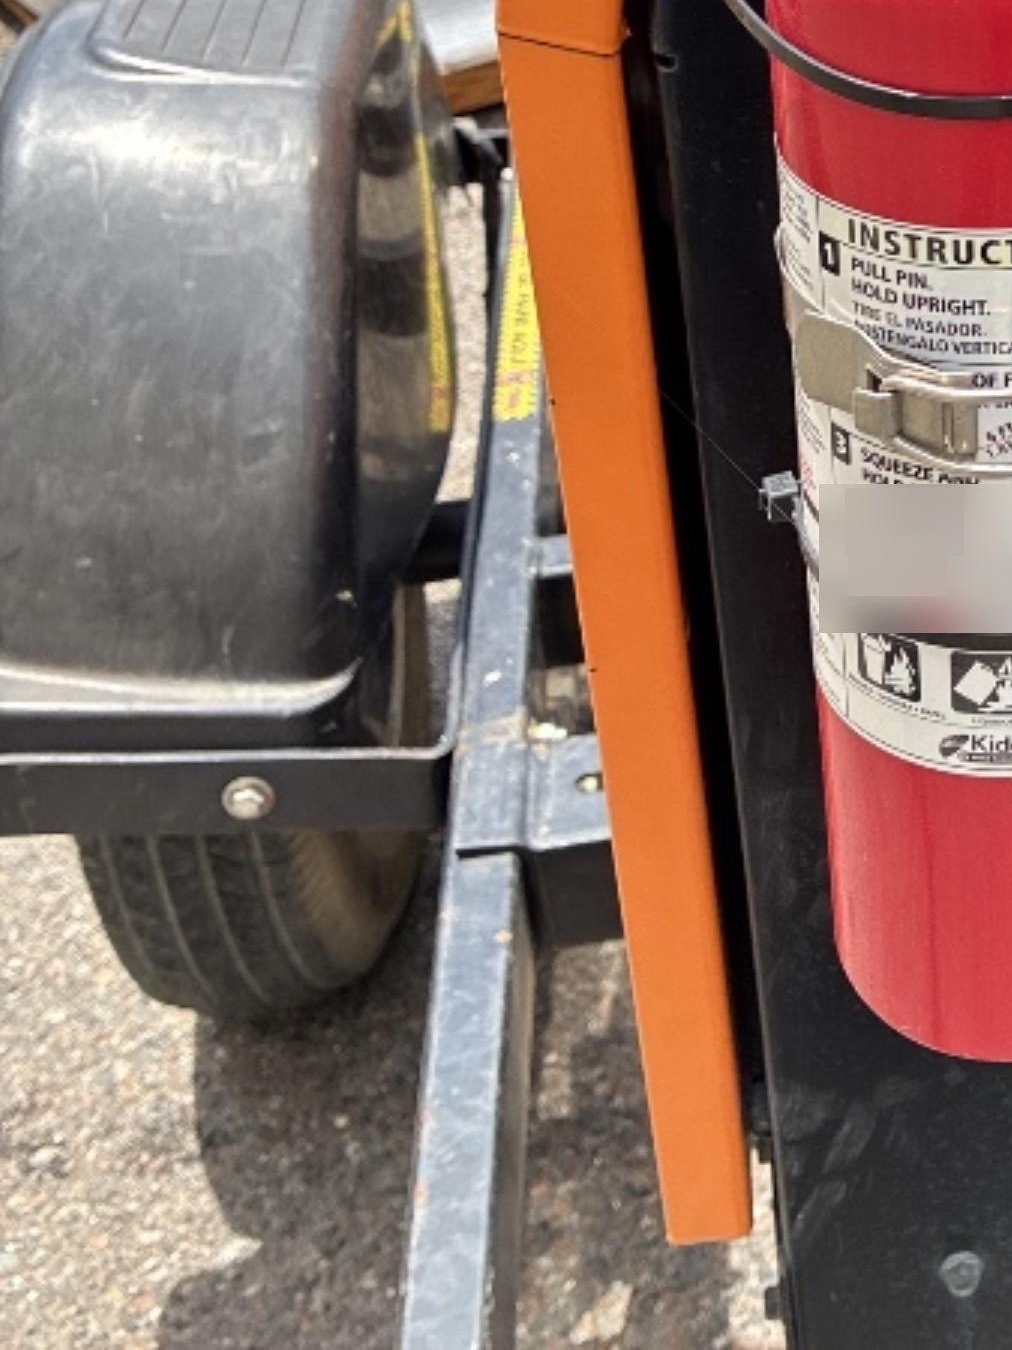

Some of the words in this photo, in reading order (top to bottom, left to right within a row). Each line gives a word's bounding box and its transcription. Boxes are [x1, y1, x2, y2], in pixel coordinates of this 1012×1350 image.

[851, 256, 892, 282] PULL
[851, 277, 898, 304] HOLD
[903, 292, 992, 316] UPRIGHT.
